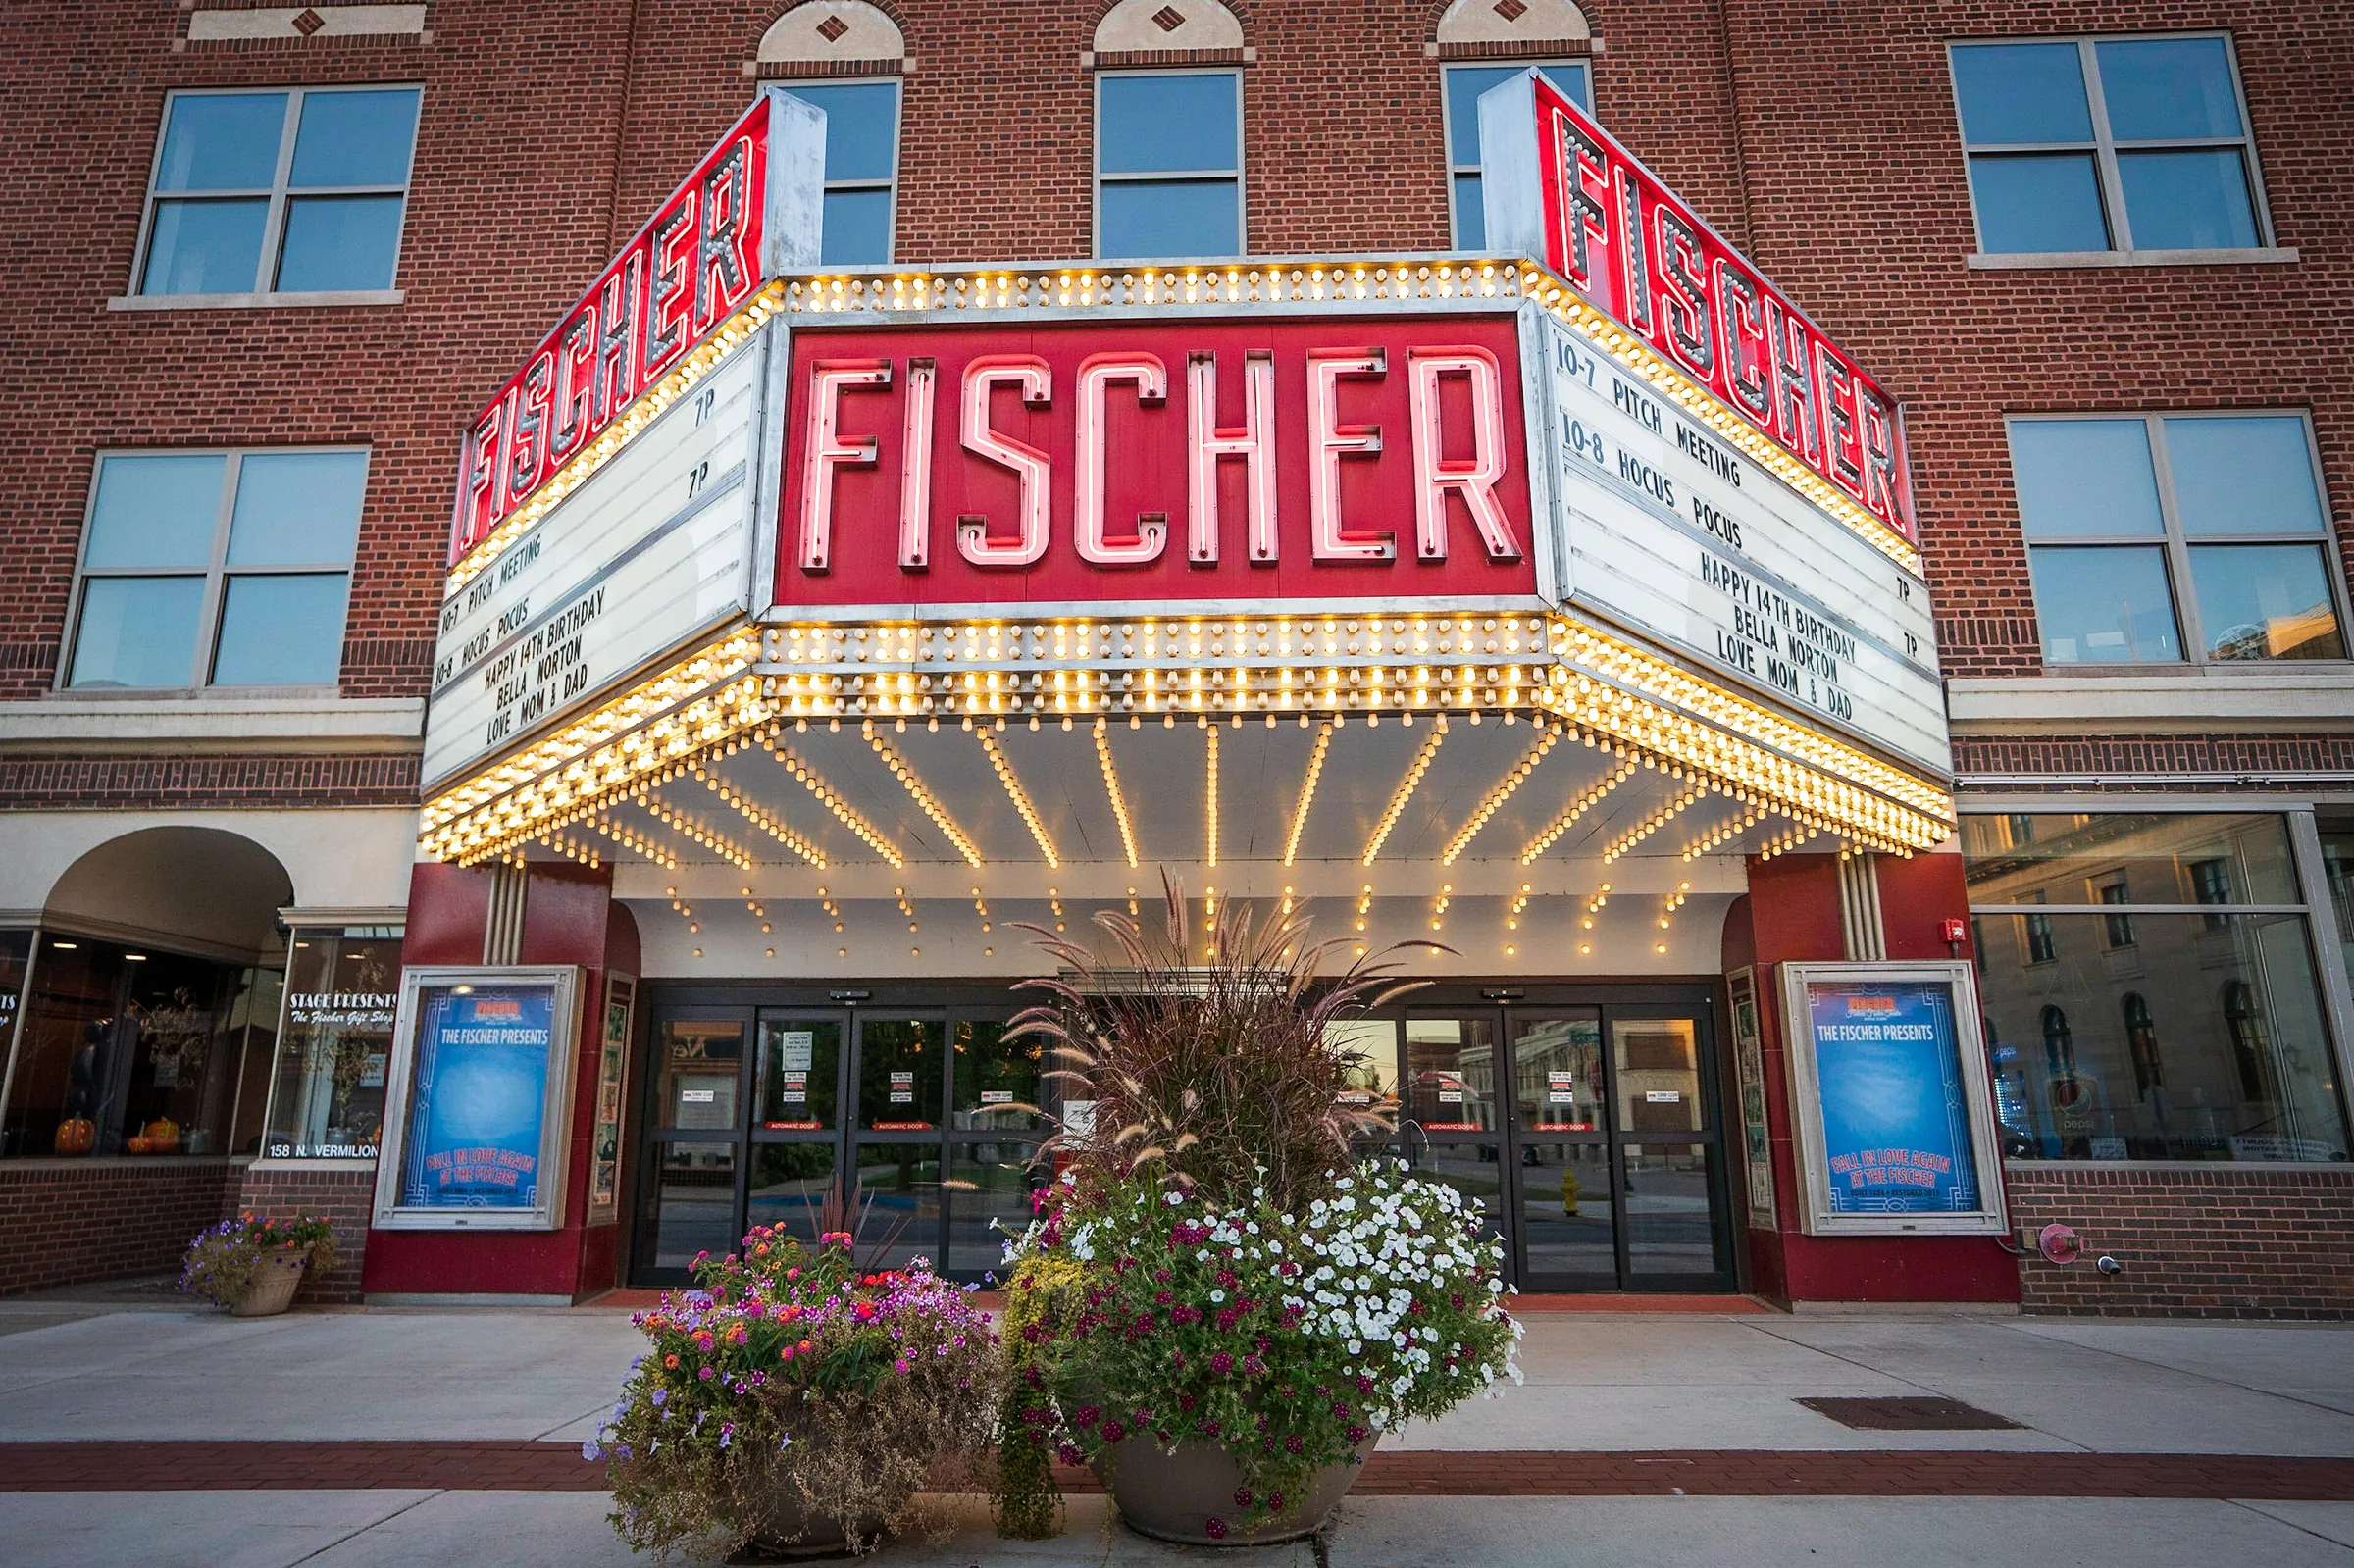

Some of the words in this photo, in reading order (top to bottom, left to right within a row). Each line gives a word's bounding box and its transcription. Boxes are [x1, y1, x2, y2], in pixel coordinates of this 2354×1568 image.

[460, 135, 753, 551] FISCHER
[1553, 107, 1906, 533] FISCHER
[798, 345, 1522, 575] FISCHER
[1557, 336, 1595, 387] 10-7
[1613, 377, 1662, 435] PITCH
[1676, 421, 1741, 487] MEETING
[1896, 576, 1911, 602] 7P
[441, 603, 459, 635] 10-7
[468, 572, 493, 613] PITCH
[499, 535, 541, 586] MEETING
[695, 388, 714, 427] 7P
[1562, 414, 1605, 465] 10-8
[1618, 448, 1675, 508] HOCUS
[1693, 496, 1743, 549] POCUS
[1904, 632, 1918, 657] 7P
[435, 657, 453, 686] 10-8
[461, 627, 490, 668] HOCUS
[497, 597, 529, 635] POCUS
[689, 461, 708, 499] 7P
[1701, 551, 1751, 604] HAPPY
[1756, 585, 1790, 628] 14TH
[1796, 608, 1856, 664] BIRTHDAY
[484, 648, 516, 691] HAPPY
[520, 630, 543, 668] 14TH
[547, 586, 605, 648] BIRTHDAY
[497, 671, 527, 711] BELLA
[537, 634, 582, 685] NORTON
[1717, 630, 1756, 674] LOVE
[1767, 655, 1799, 695] MOM
[1828, 686, 1853, 721] DAD
[1734, 605, 1778, 653] BELLA
[1788, 634, 1838, 683] NORTON
[486, 710, 511, 745] LOVE
[521, 687, 544, 726] MOM
[564, 663, 588, 700] DAD
[289, 993, 332, 1009] STAGE
[291, 1011, 309, 1023] The
[311, 1011, 344, 1024] Fischer
[347, 1011, 368, 1026] Gift
[441, 1029, 460, 1044] THE
[461, 1029, 499, 1044] FISCHER
[500, 1029, 548, 1045] PRESENTS
[1817, 1025, 1838, 1041] THE
[1840, 1025, 1882, 1041] FISCHER
[1883, 1025, 1934, 1041] PRESENTS
[270, 1145, 290, 1157] 158
[296, 1145, 307, 1157] N.
[315, 1145, 378, 1157] VERMILION
[426, 1150, 452, 1171] FALL
[454, 1148, 467, 1165] IN
[468, 1147, 498, 1165] LOVE
[499, 1149, 536, 1174] AGAIN
[1830, 1152, 1860, 1174] FALL
[1861, 1149, 1875, 1166] IN
[1877, 1148, 1909, 1166] LOVE
[1911, 1151, 1951, 1173] AGAIN
[2063, 1118, 2095, 1131] pepsi
[440, 1169, 451, 1186] AT
[453, 1166, 473, 1183] THE
[474, 1166, 518, 1187] FISCHER
[1850, 1171, 1865, 1189] AT
[1865, 1167, 1887, 1186] THE
[1888, 1167, 1935, 1189] FISCHER
